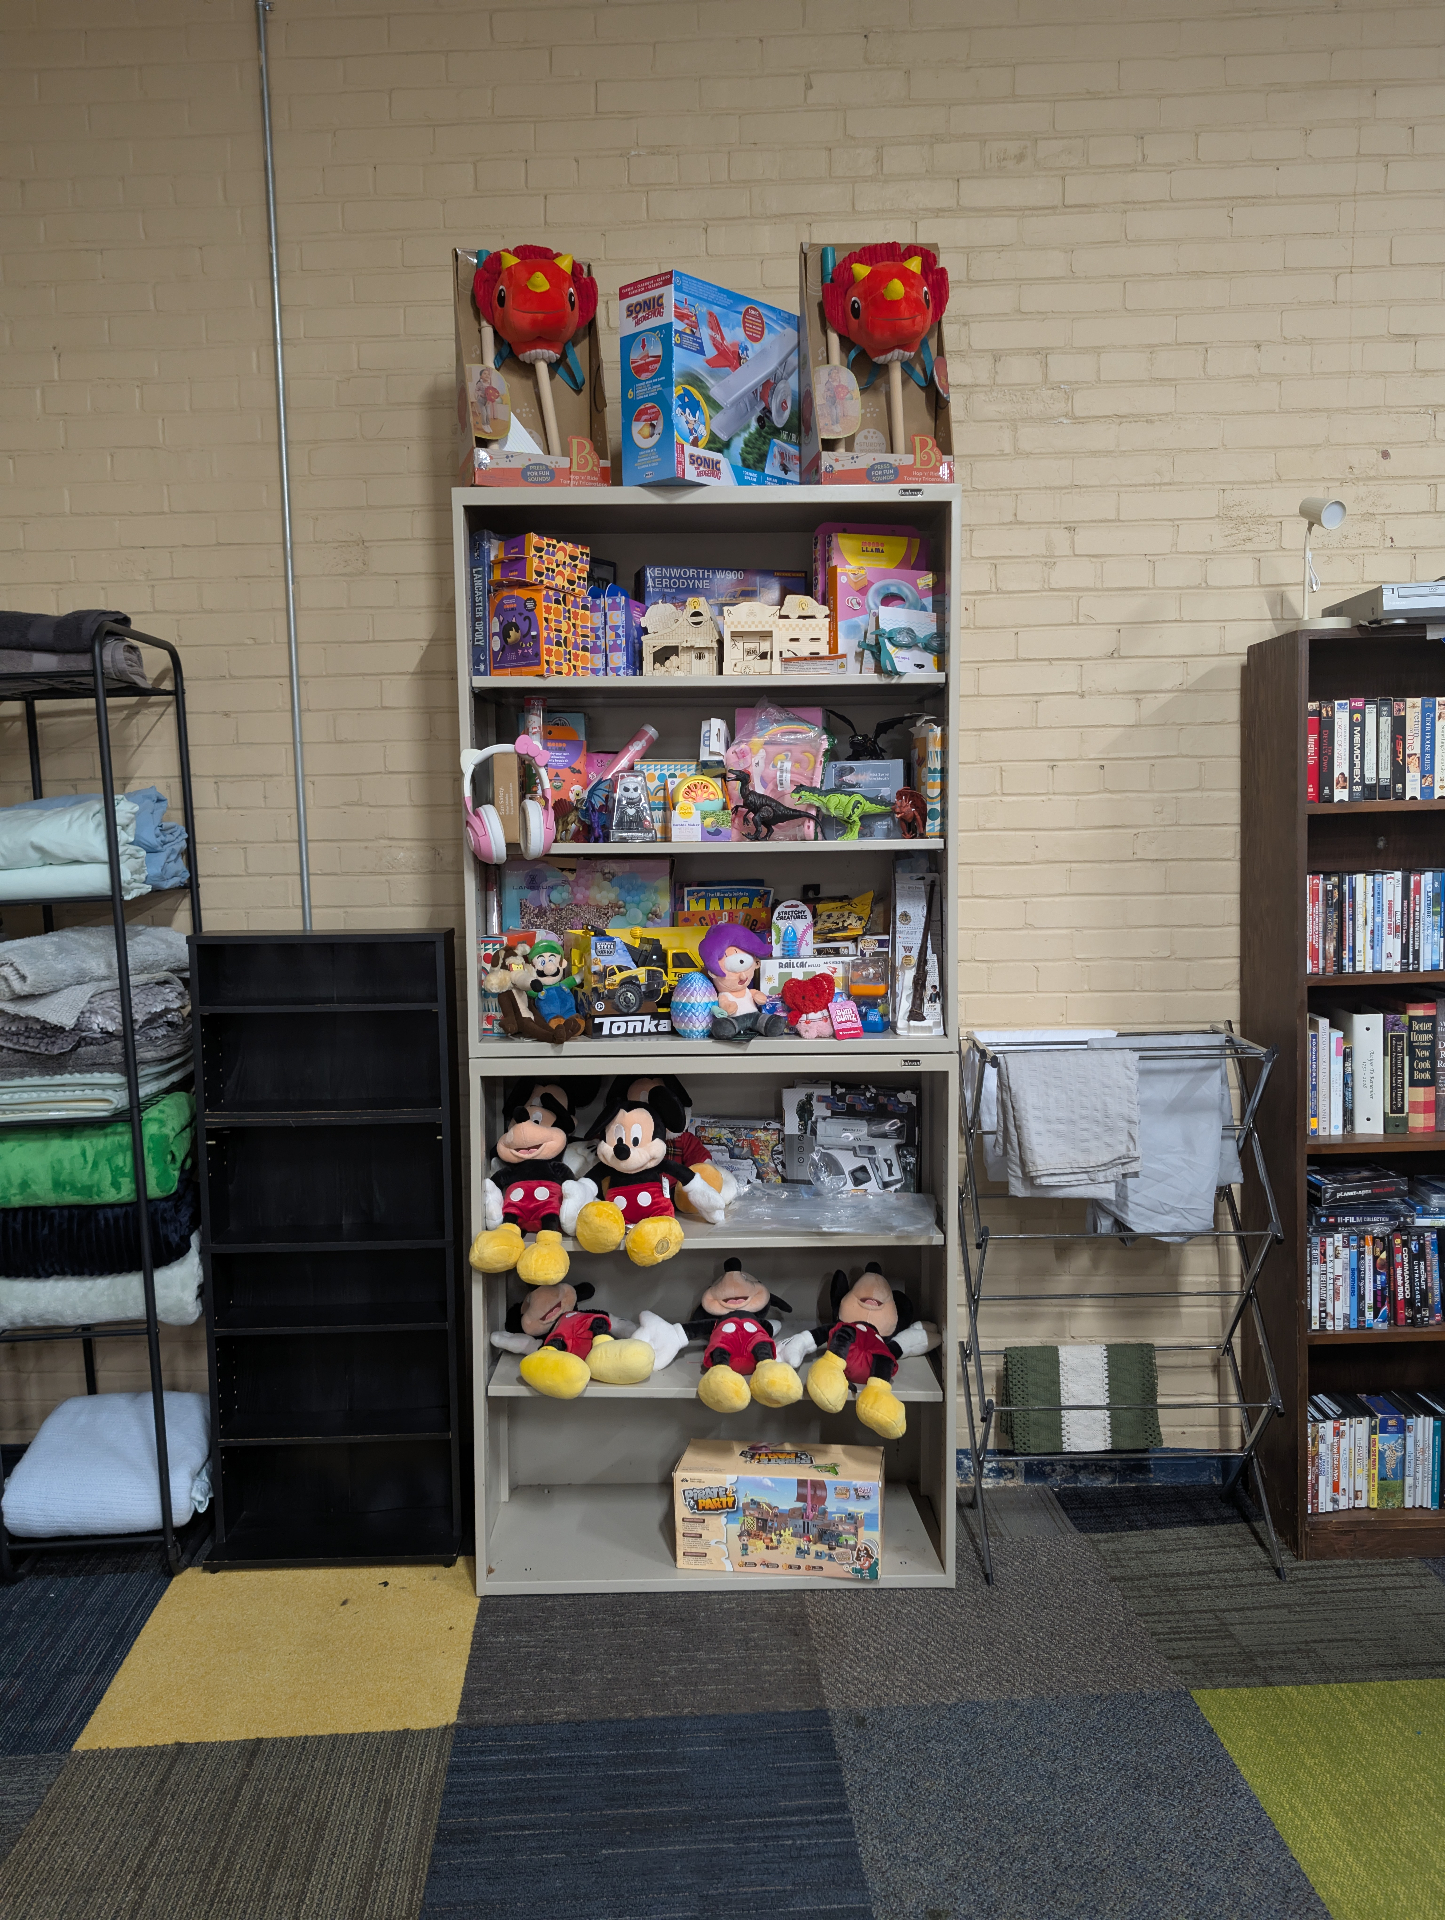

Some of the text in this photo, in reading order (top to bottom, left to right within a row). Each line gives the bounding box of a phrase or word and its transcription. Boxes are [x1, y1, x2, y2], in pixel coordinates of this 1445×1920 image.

[625, 294, 664, 320] SONIC
[634, 308, 665, 328] HEDGEHOG
[628, 388, 634, 400] 6
[689, 453, 722, 470] SONIC
[696, 470, 722, 480] HEDGEHOG
[646, 568, 744, 580] KENWORTH W900
[646, 578, 710, 589] AERODYNE
[472, 568, 484, 620] LANCASTER
[474, 622, 484, 646] OPOLY
[1308, 734, 1317, 755] Hanging
[1407, 734, 1414, 751] me
[690, 897, 763, 912] MANGA
[594, 1014, 672, 1036] Tonka
[1412, 1020, 1432, 1031] Better
[1410, 1032, 1433, 1042] Homes
[1415, 1048, 1430, 1058] New
[1414, 1059, 1431, 1069] Cook
[1414, 1071, 1431, 1080] Book
[684, 1488, 726, 1500] PIRATE
[698, 1496, 734, 1510] PARTY
